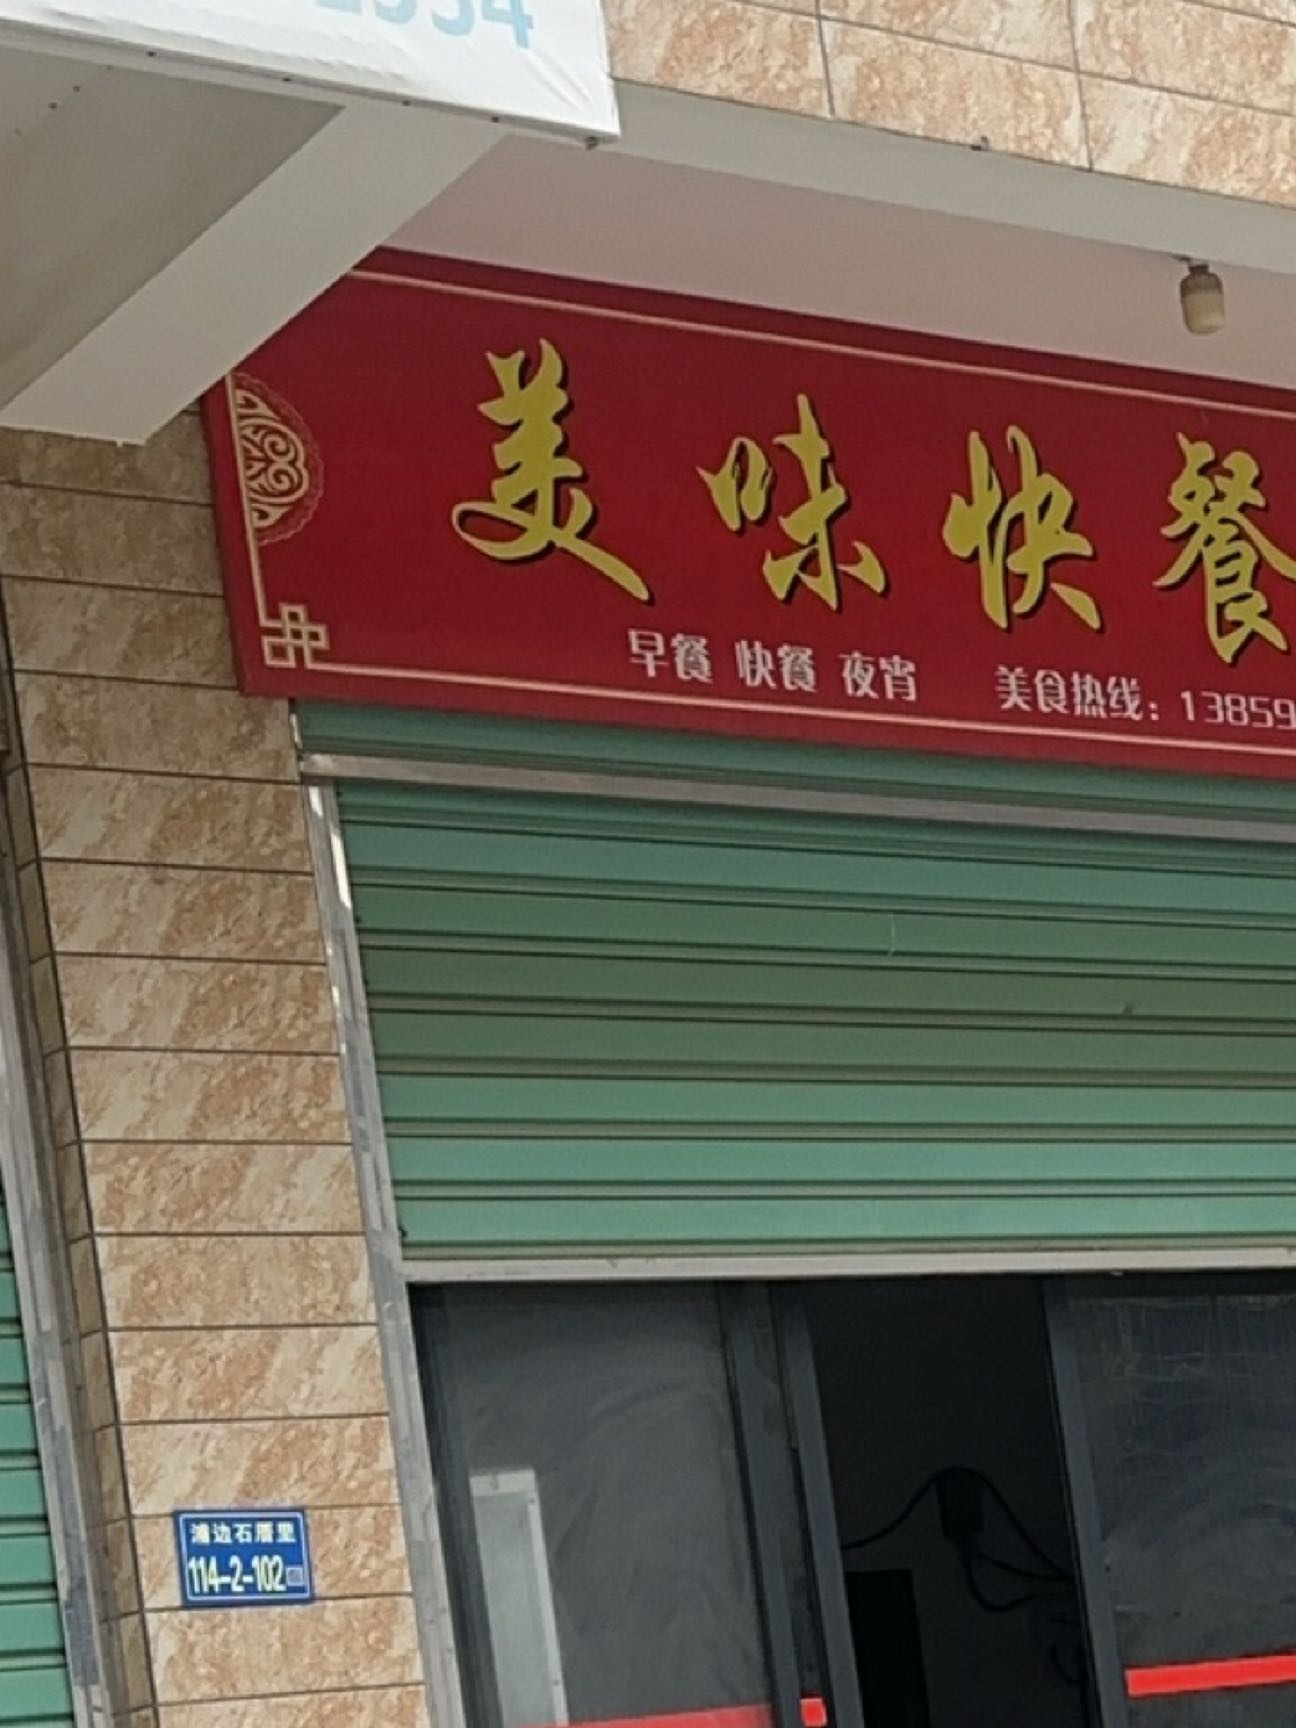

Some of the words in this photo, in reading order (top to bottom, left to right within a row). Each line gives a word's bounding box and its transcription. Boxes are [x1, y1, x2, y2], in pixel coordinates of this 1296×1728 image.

[628, 628, 714, 683] 早餐
[735, 639, 818, 692] 快餐
[839, 650, 917, 702] 夜宵
[188, 1554, 287, 1594] 114-2-102
